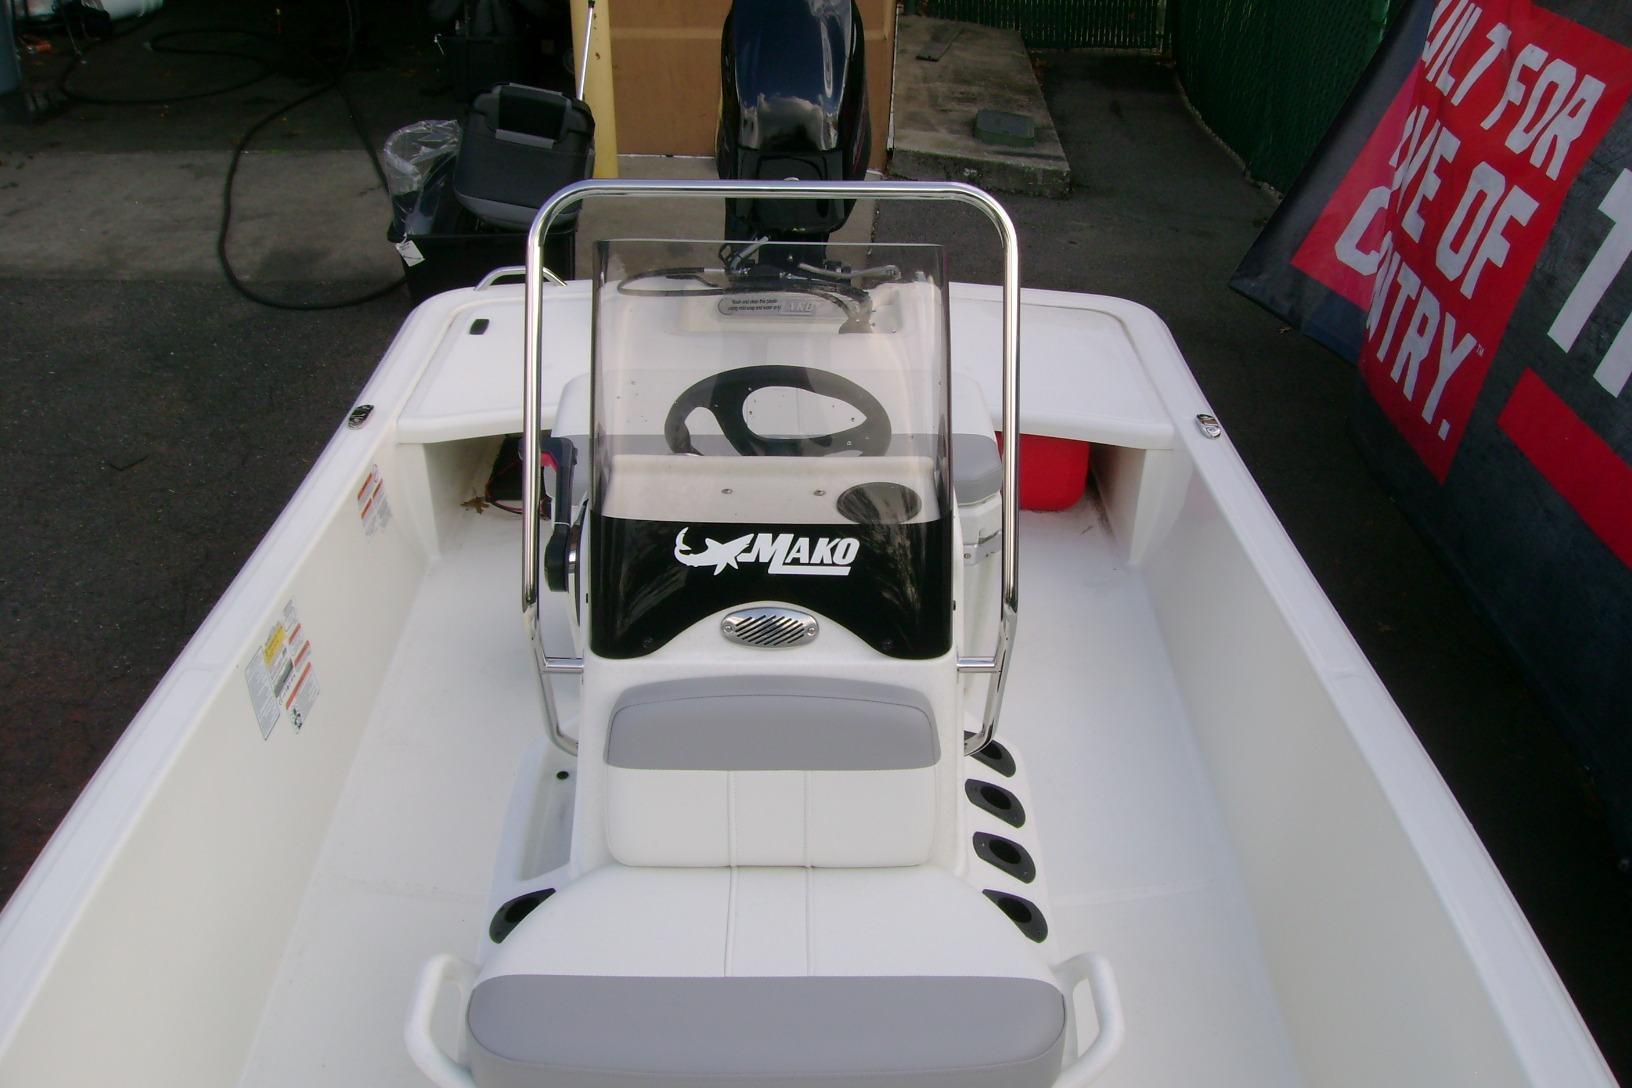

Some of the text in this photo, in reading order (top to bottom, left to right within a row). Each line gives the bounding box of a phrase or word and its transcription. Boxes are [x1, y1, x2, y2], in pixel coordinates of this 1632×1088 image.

[1421, 0, 1606, 181] UILT FOR
[1435, 161, 1540, 300] OF
[736, 533, 861, 576] MAKO
